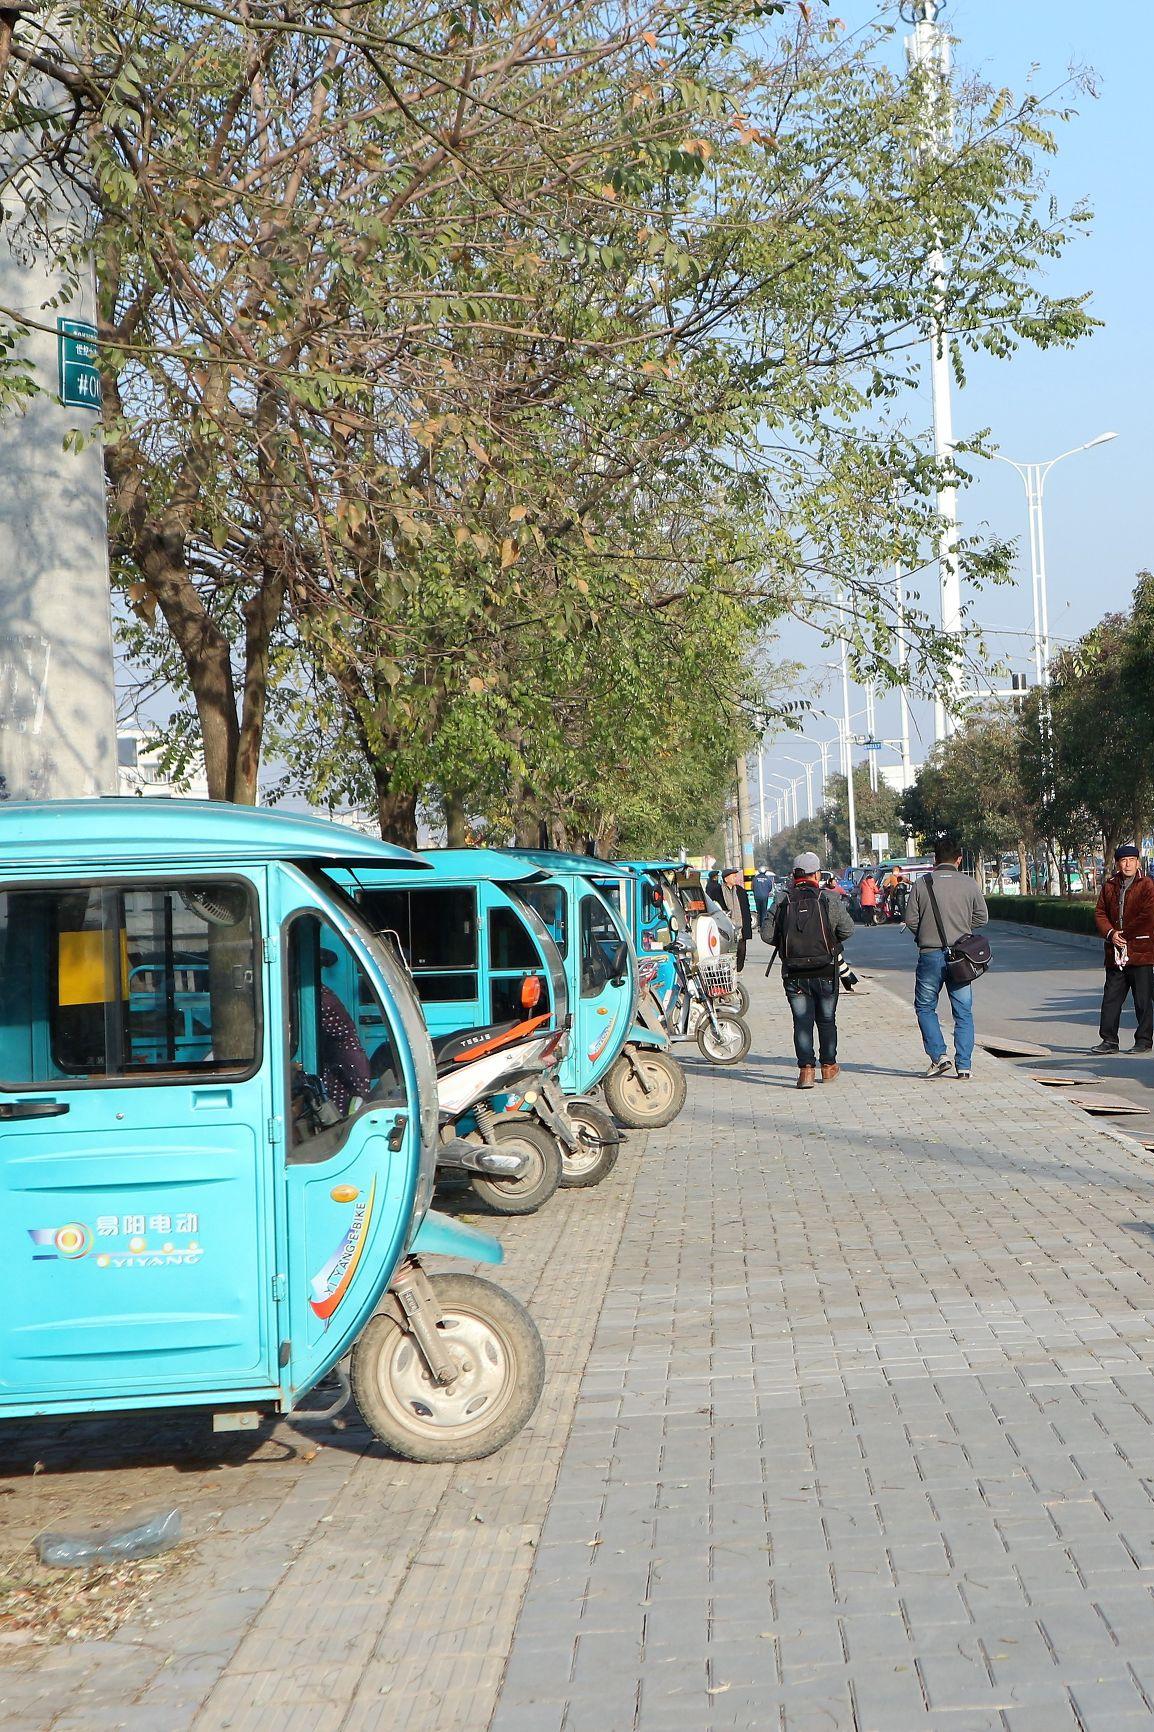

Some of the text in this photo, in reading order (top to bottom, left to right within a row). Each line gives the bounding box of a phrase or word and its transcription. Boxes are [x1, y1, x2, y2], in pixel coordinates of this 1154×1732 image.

[96, 1212, 200, 1236] 易阳电动
[112, 1254, 201, 1267] YIYANG
